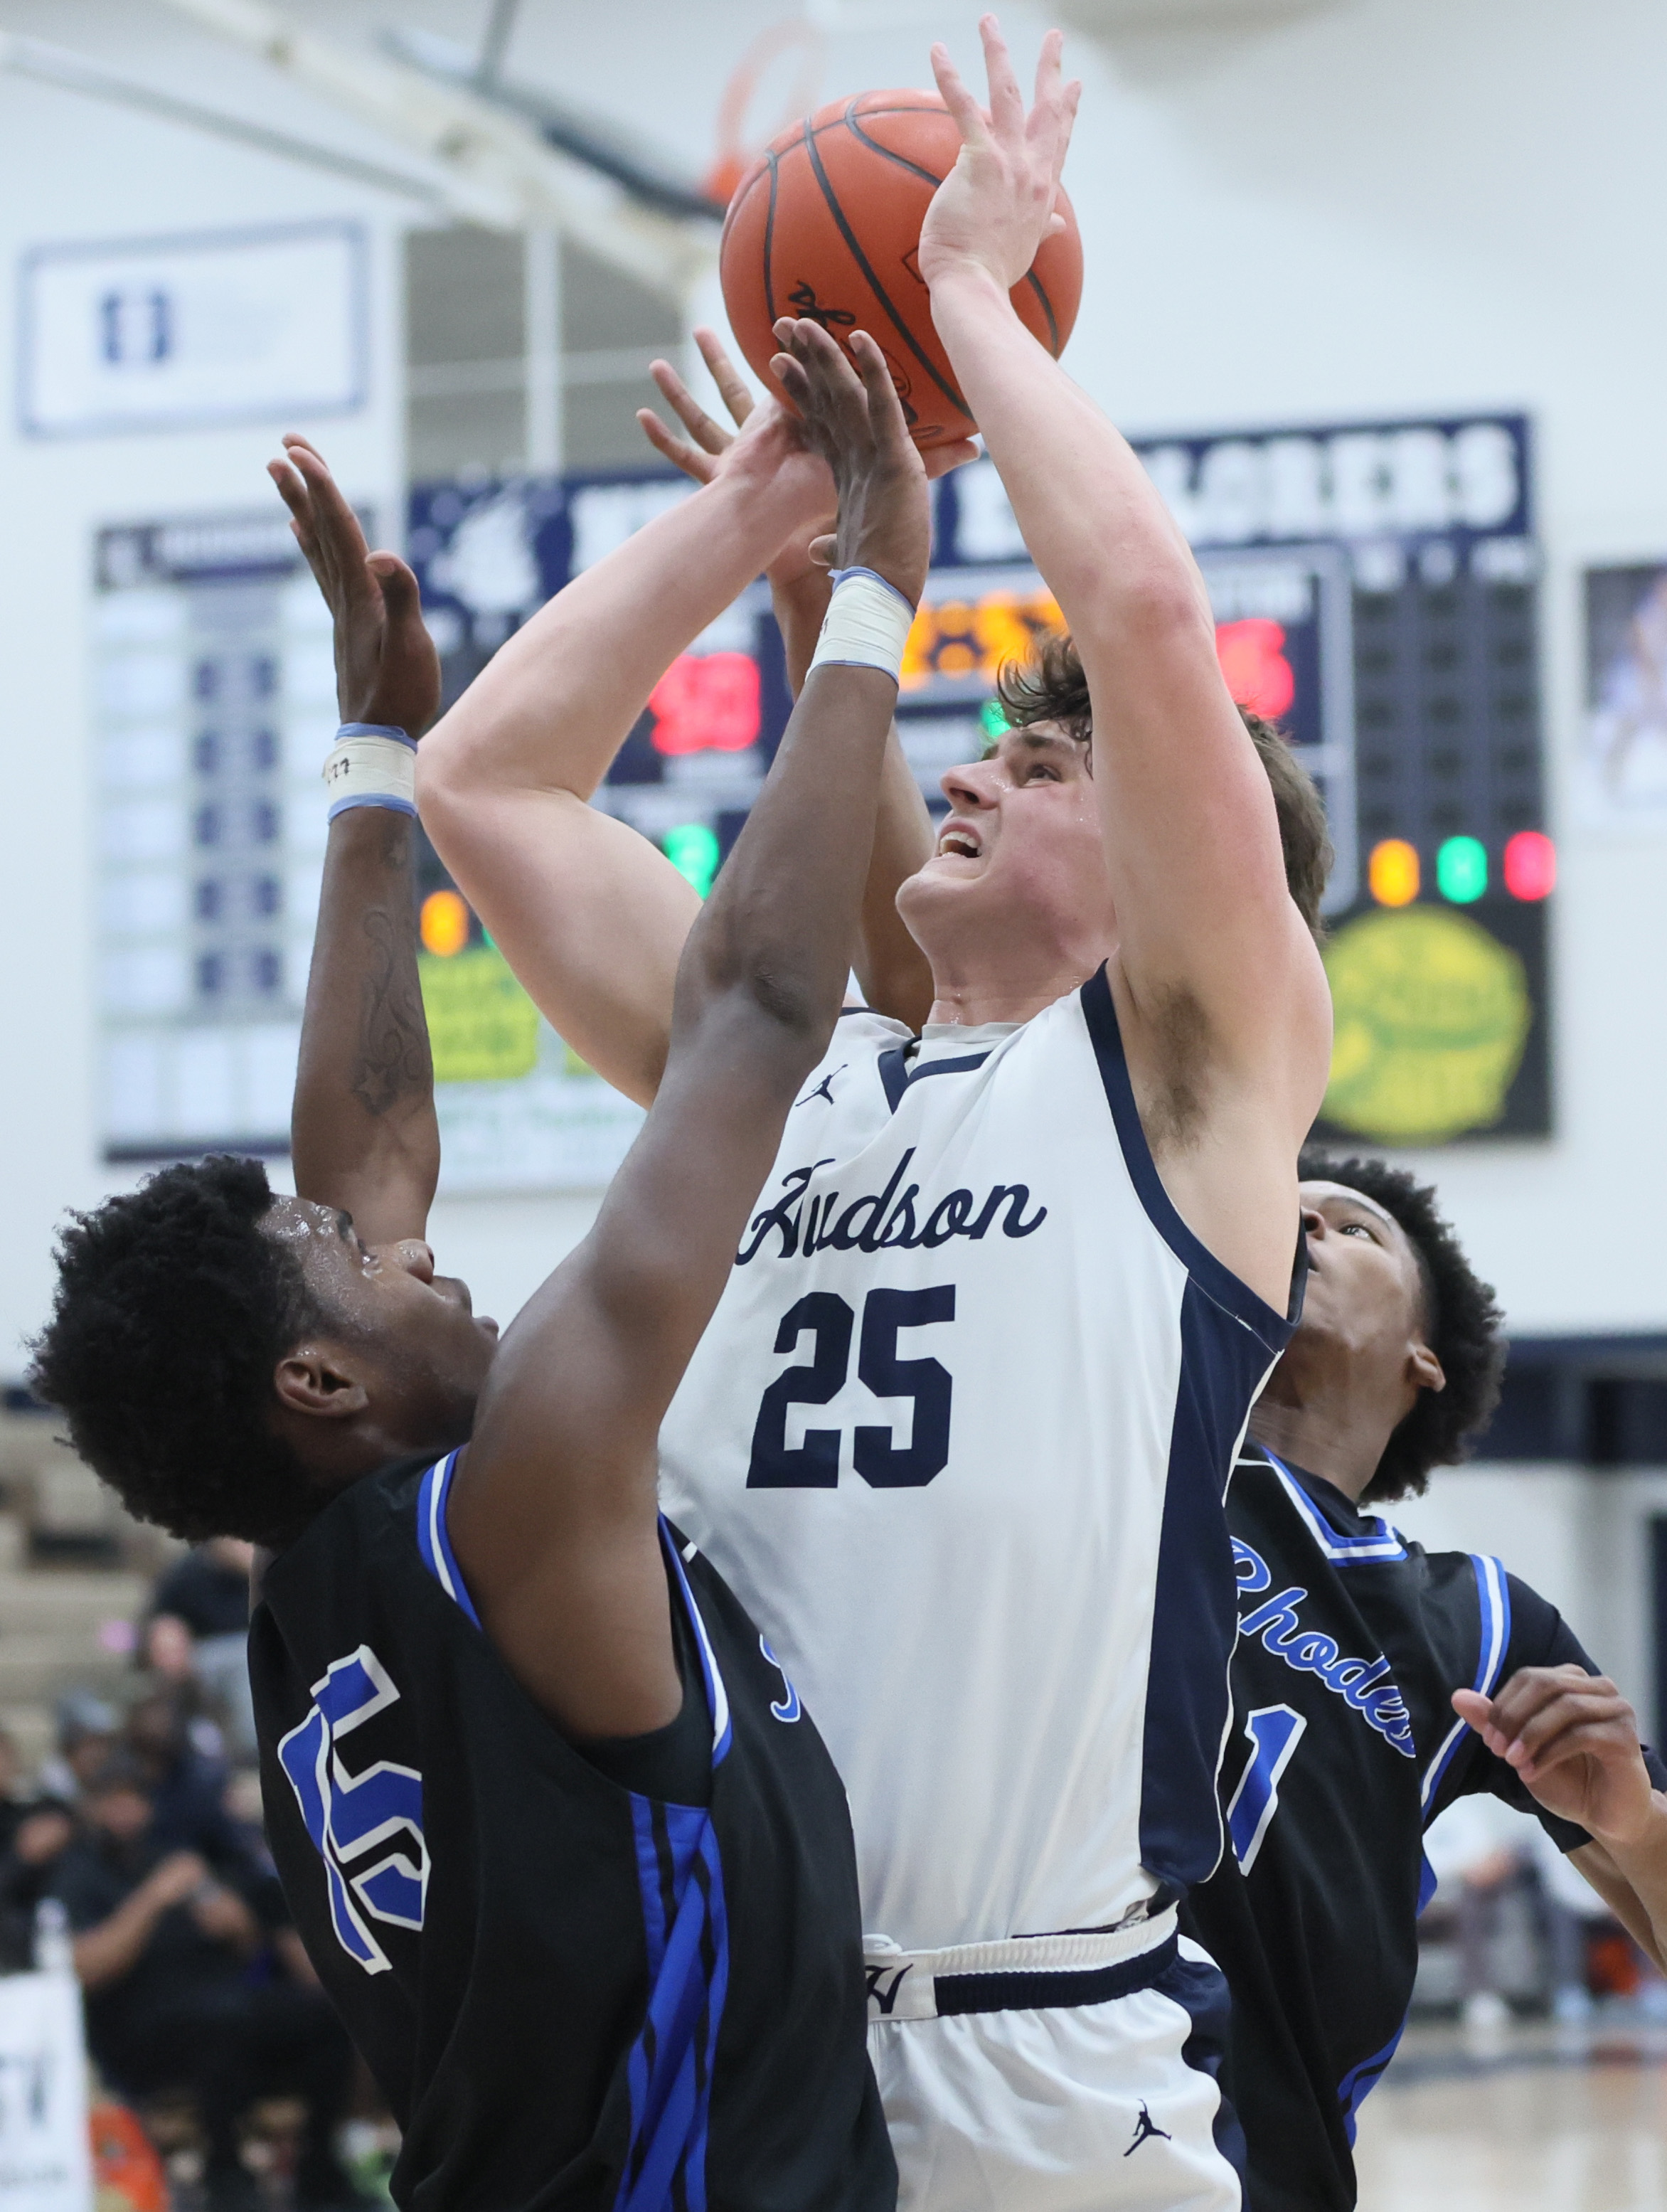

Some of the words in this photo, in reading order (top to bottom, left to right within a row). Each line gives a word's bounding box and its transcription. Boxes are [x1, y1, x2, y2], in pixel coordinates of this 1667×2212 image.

[735, 1147, 1048, 1266] Hudson
[746, 1284, 956, 1489] 25
[1226, 1703, 1307, 1877] 1
